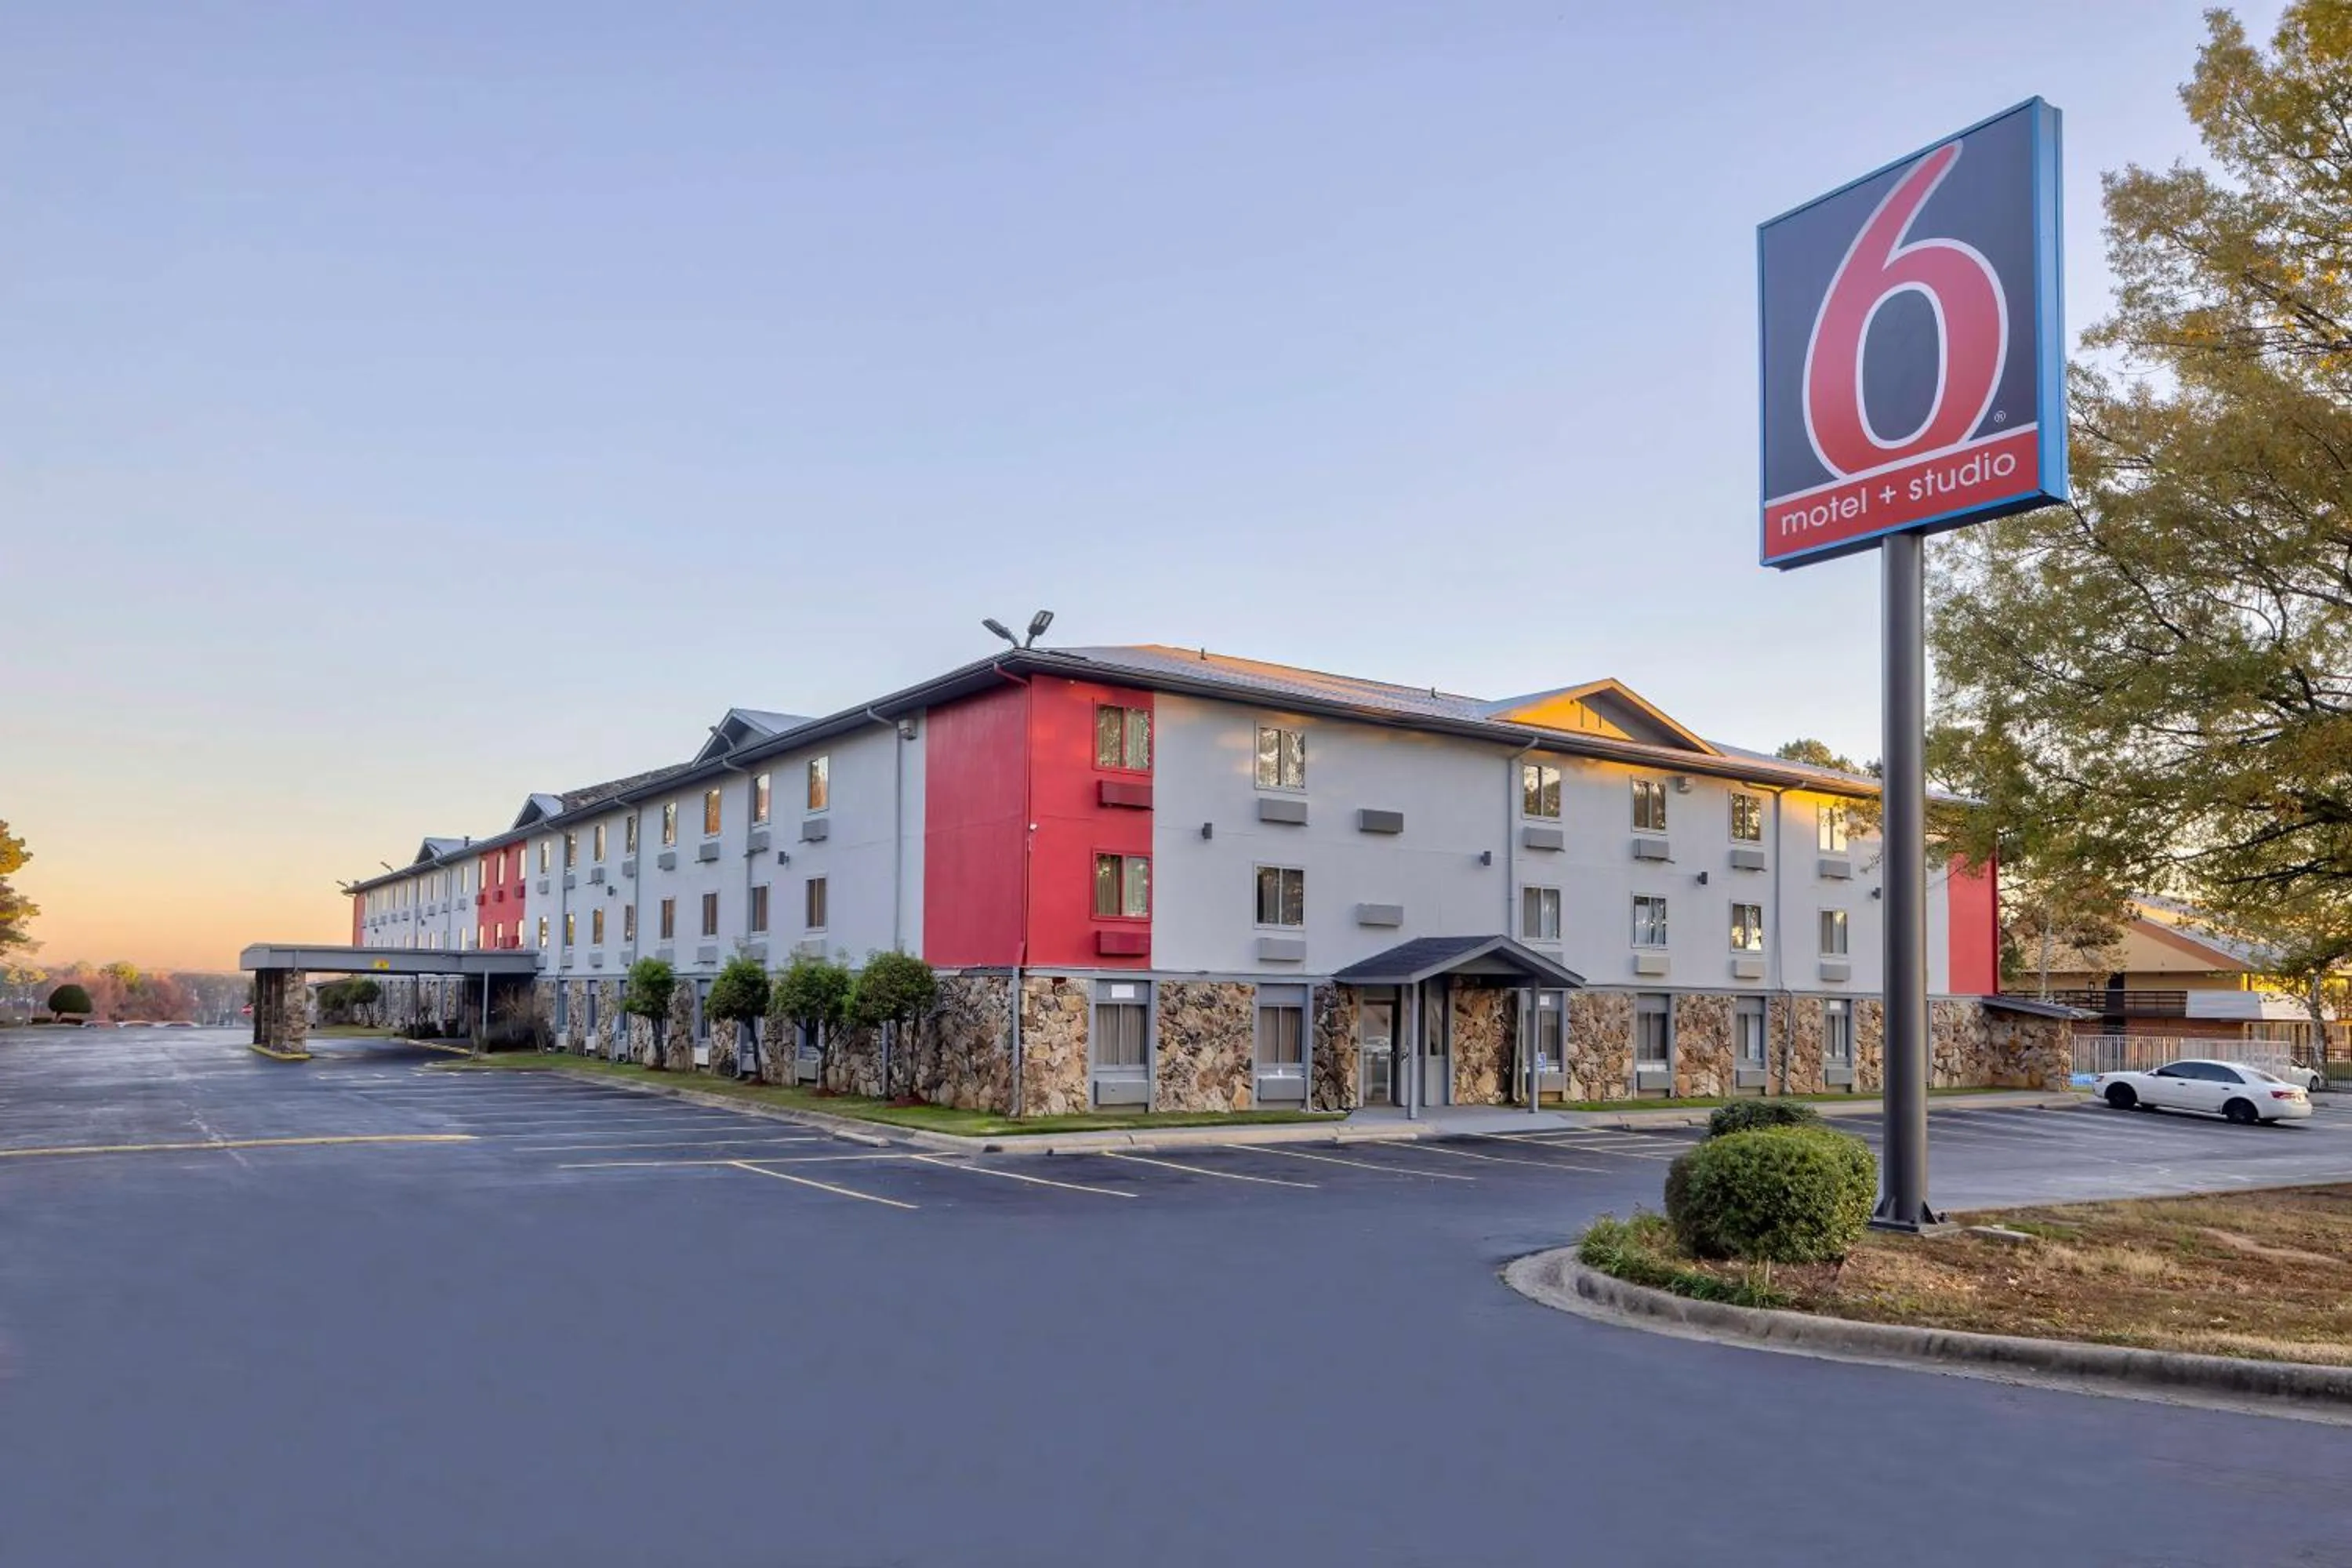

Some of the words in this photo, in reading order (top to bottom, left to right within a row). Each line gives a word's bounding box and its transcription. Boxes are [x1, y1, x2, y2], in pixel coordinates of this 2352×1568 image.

[1803, 139, 2009, 480] 6
[1781, 487, 1867, 535] motel
[1879, 485, 1896, 504] +
[1908, 452, 2016, 500] studio
